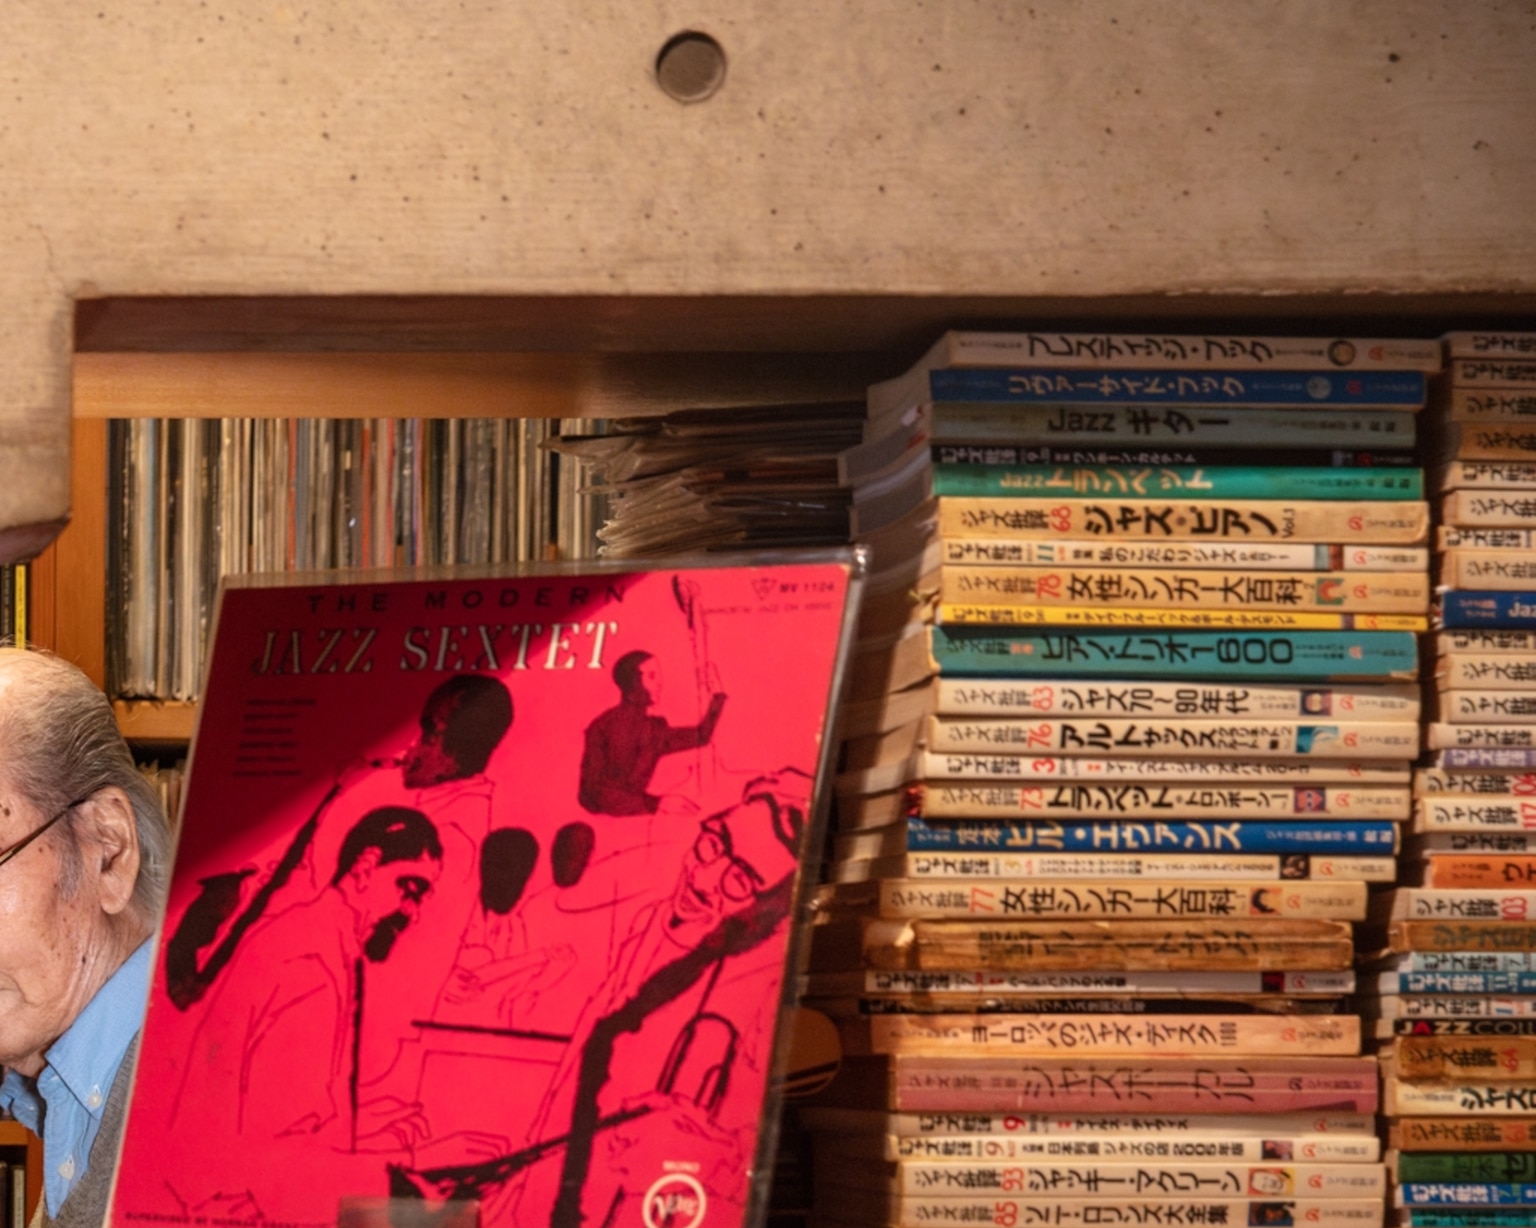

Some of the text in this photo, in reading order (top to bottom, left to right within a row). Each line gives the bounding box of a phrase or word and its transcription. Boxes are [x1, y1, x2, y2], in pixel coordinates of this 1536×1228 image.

[1047, 408, 1230, 435] Jazz ギター
[1000, 467, 1213, 496] Jazz トランペット
[1050, 505, 1071, 532] 68
[1083, 505, 1279, 537] ジャズ・ピアノ
[1282, 508, 1296, 538] Vol.1
[1037, 544, 1054, 562] 11
[307, 585, 627, 614] THE MODERN
[1036, 573, 1061, 599] 78
[1066, 572, 1304, 605] 女性シンガー大百科
[251, 620, 620, 677] JAZZ SEXTET
[1032, 686, 1055, 711] 83
[1027, 723, 1053, 748] 76
[1060, 722, 1218, 750] アルトサックス
[1031, 757, 1056, 775] 3
[1020, 785, 1045, 810] 73
[1434, 805, 1518, 825] ジャズ批評
[956, 824, 1003, 845] 定本
[1005, 821, 1242, 849] ビル・エヴァンス
[969, 886, 995, 913] 77
[999, 885, 1237, 915] 女性シンガー大百科
[1416, 896, 1528, 921] ジャズ批評 103
[1399, 1021, 1472, 1036] JAZZ
[1002, 1115, 1026, 1132] 9
[984, 1141, 1005, 1157] 9
[915, 1167, 1241, 1193] ジャズ批評 93 ジャッキー・マクリーン
[915, 1200, 1229, 1228] ジャズ批評 85 ソニー・ロリンズ大全集
